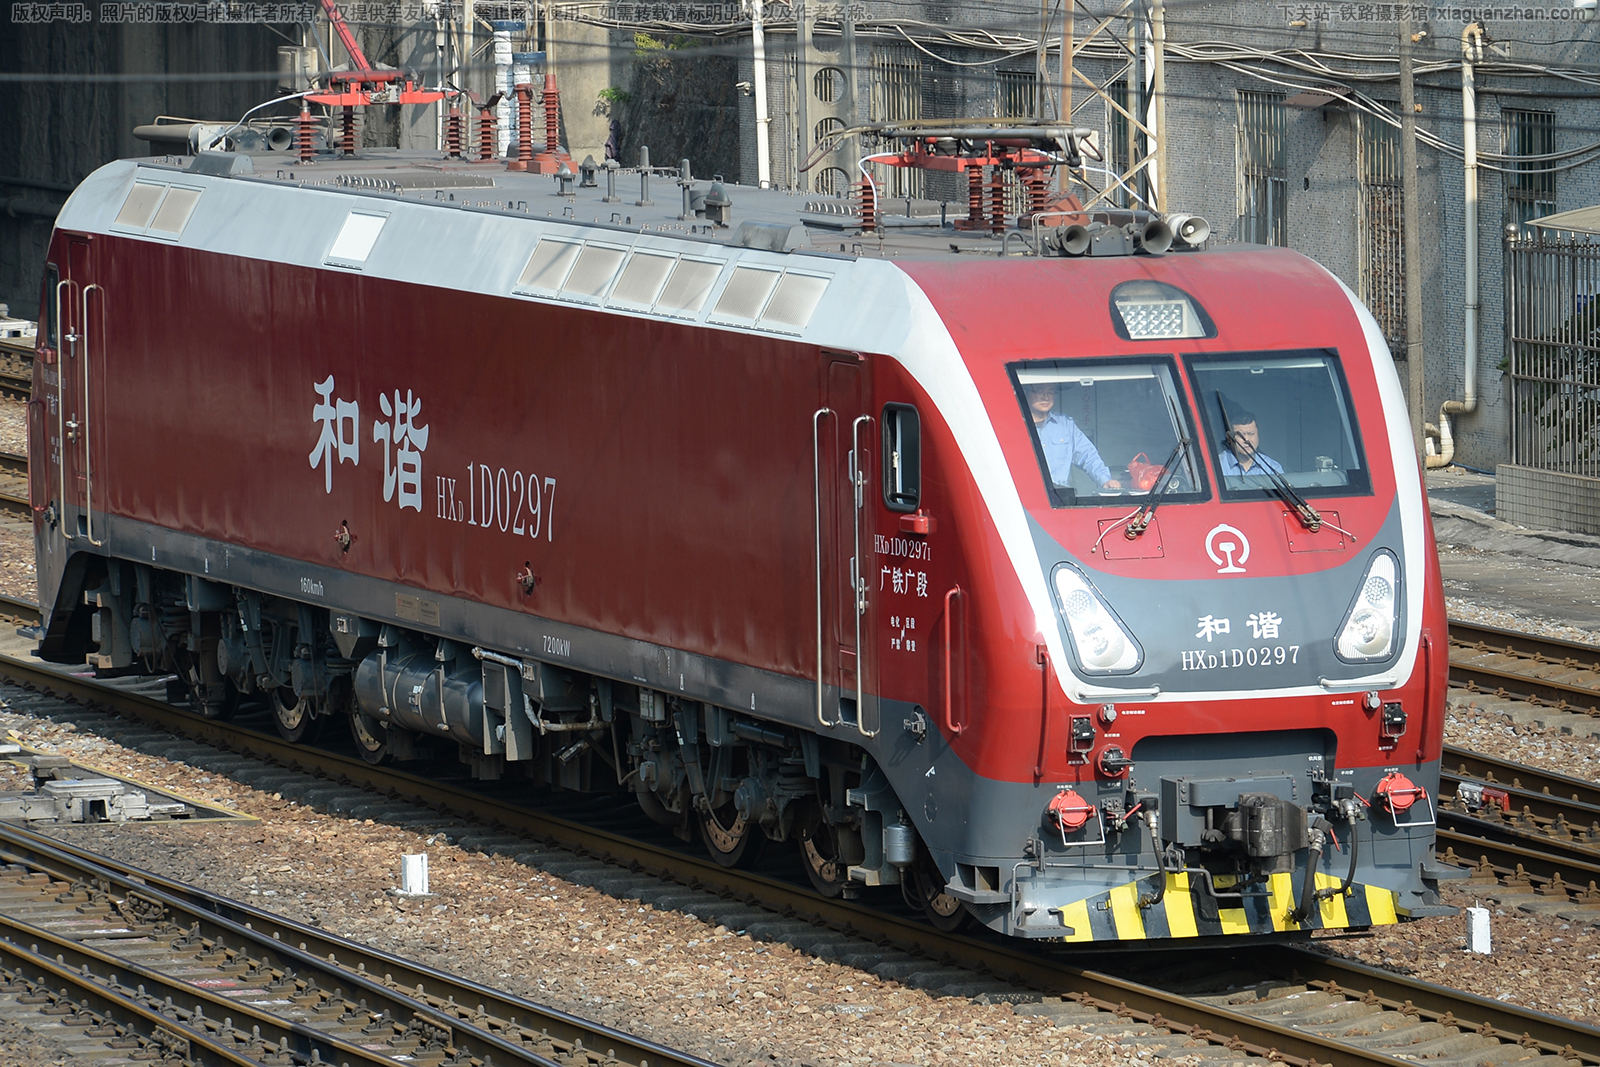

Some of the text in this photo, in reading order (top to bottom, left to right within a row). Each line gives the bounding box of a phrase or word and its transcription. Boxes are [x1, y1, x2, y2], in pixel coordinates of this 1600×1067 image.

[308, 374, 429, 513] 和谐
[436, 461, 557, 543] HXD1D0297
[880, 565, 928, 597] 广铁广段
[1195, 611, 1282, 642] 和谐
[543, 635, 570, 657] 7200kW
[1181, 645, 1300, 671] HXD1D0297
